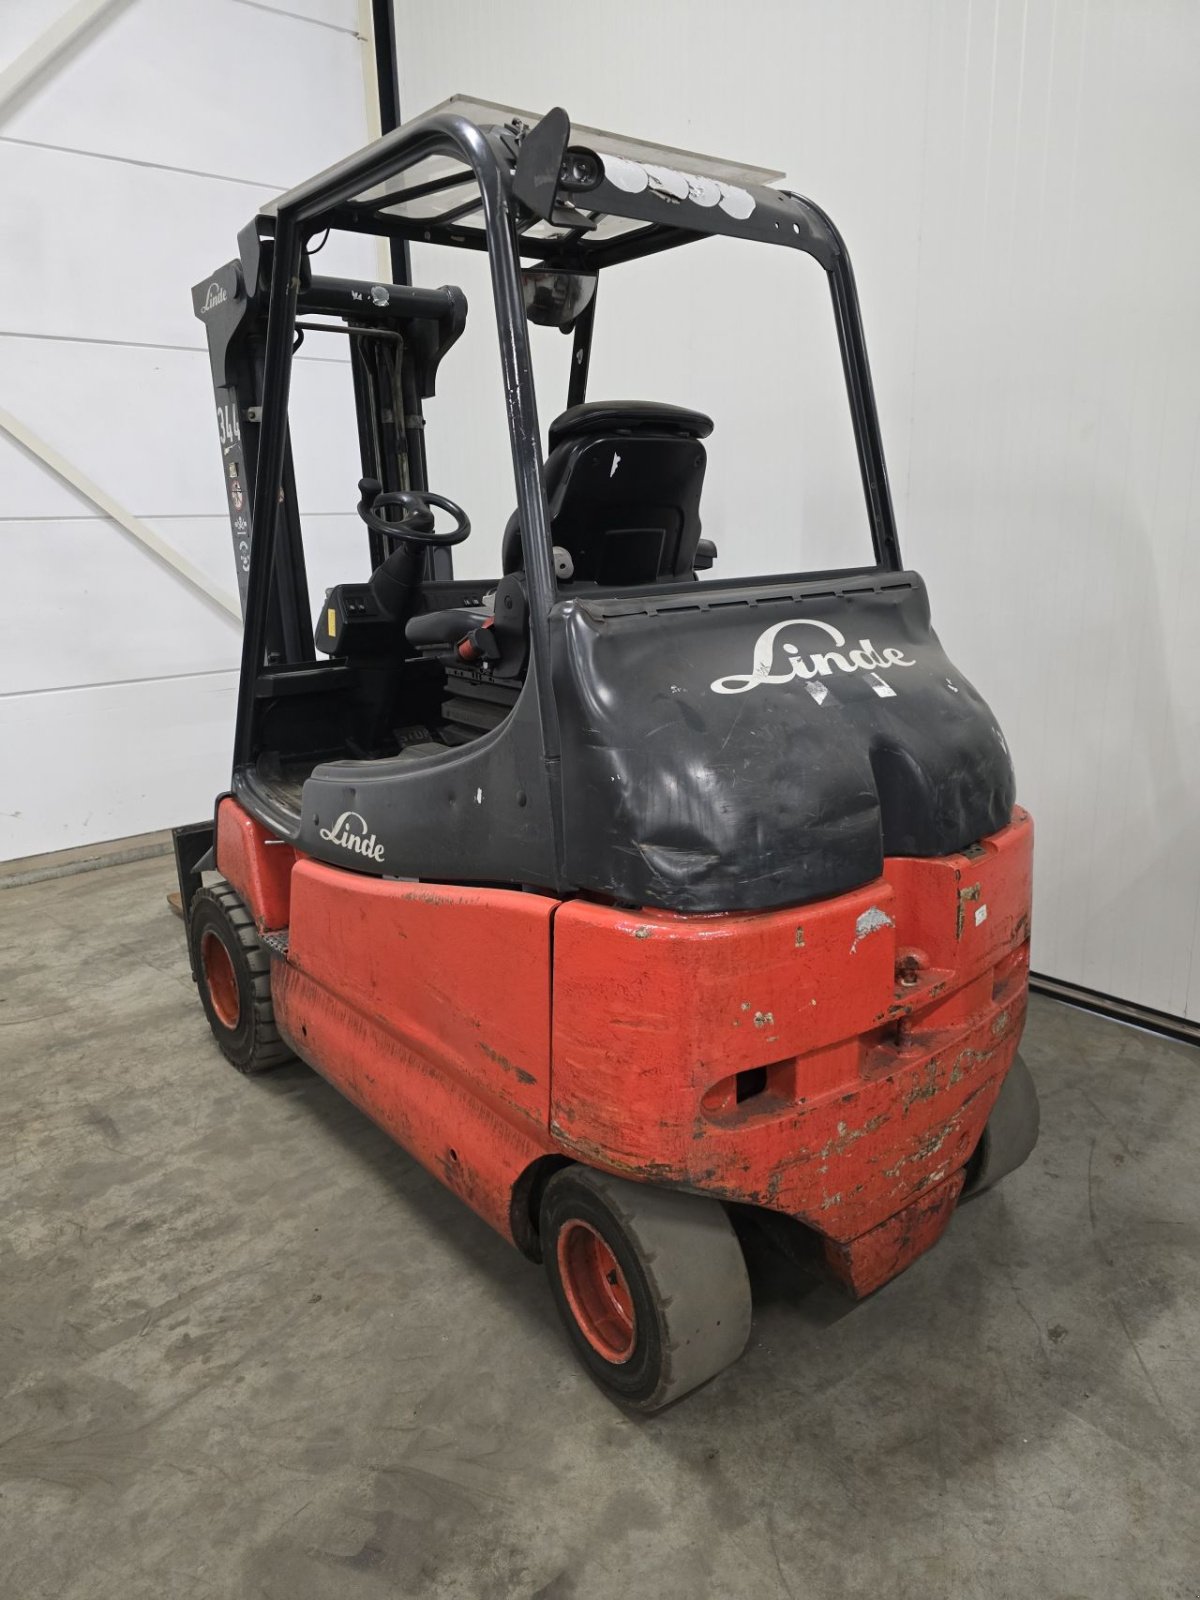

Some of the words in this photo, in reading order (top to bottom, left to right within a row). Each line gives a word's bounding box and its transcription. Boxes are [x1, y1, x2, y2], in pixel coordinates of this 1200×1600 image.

[217, 403, 241, 443] 344
[710, 618, 916, 694] Linde
[319, 811, 385, 862] Linde
